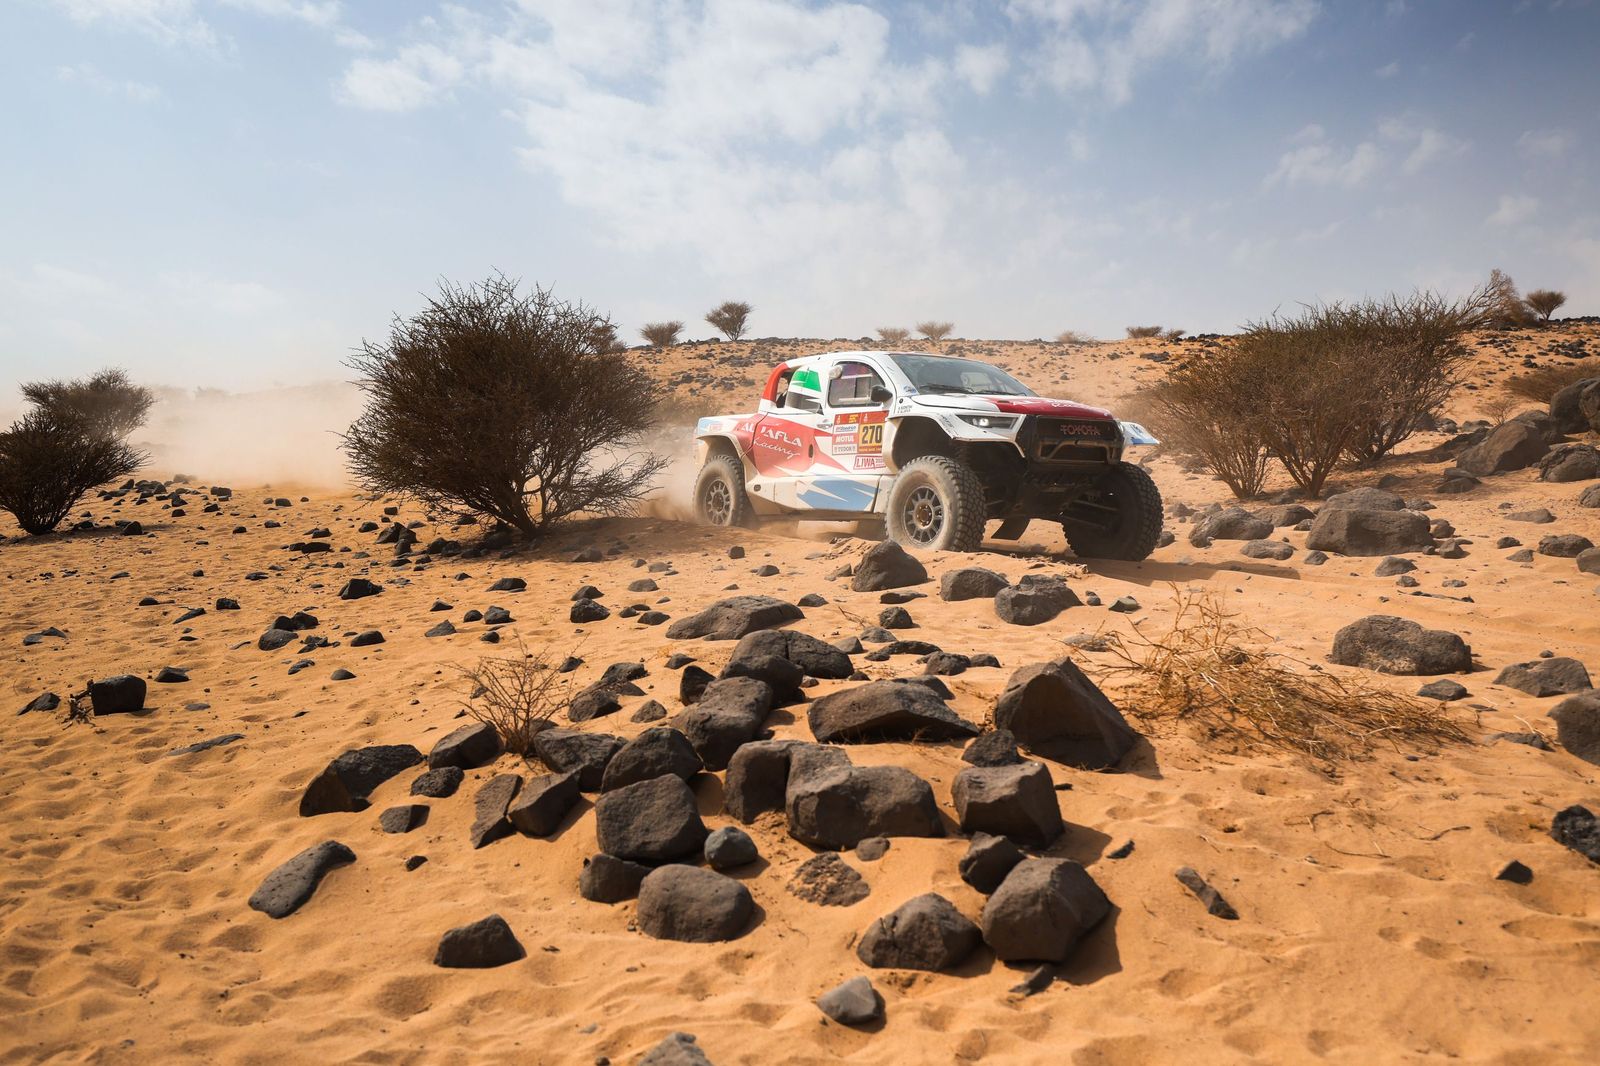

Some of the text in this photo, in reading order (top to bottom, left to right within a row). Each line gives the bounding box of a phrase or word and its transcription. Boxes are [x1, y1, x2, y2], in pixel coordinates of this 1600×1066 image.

[861, 425, 883, 444] 270
[1060, 425, 1102, 436] TOYOTA
[836, 435, 854, 443] MOTUL
[856, 458, 875, 468] LIWA
